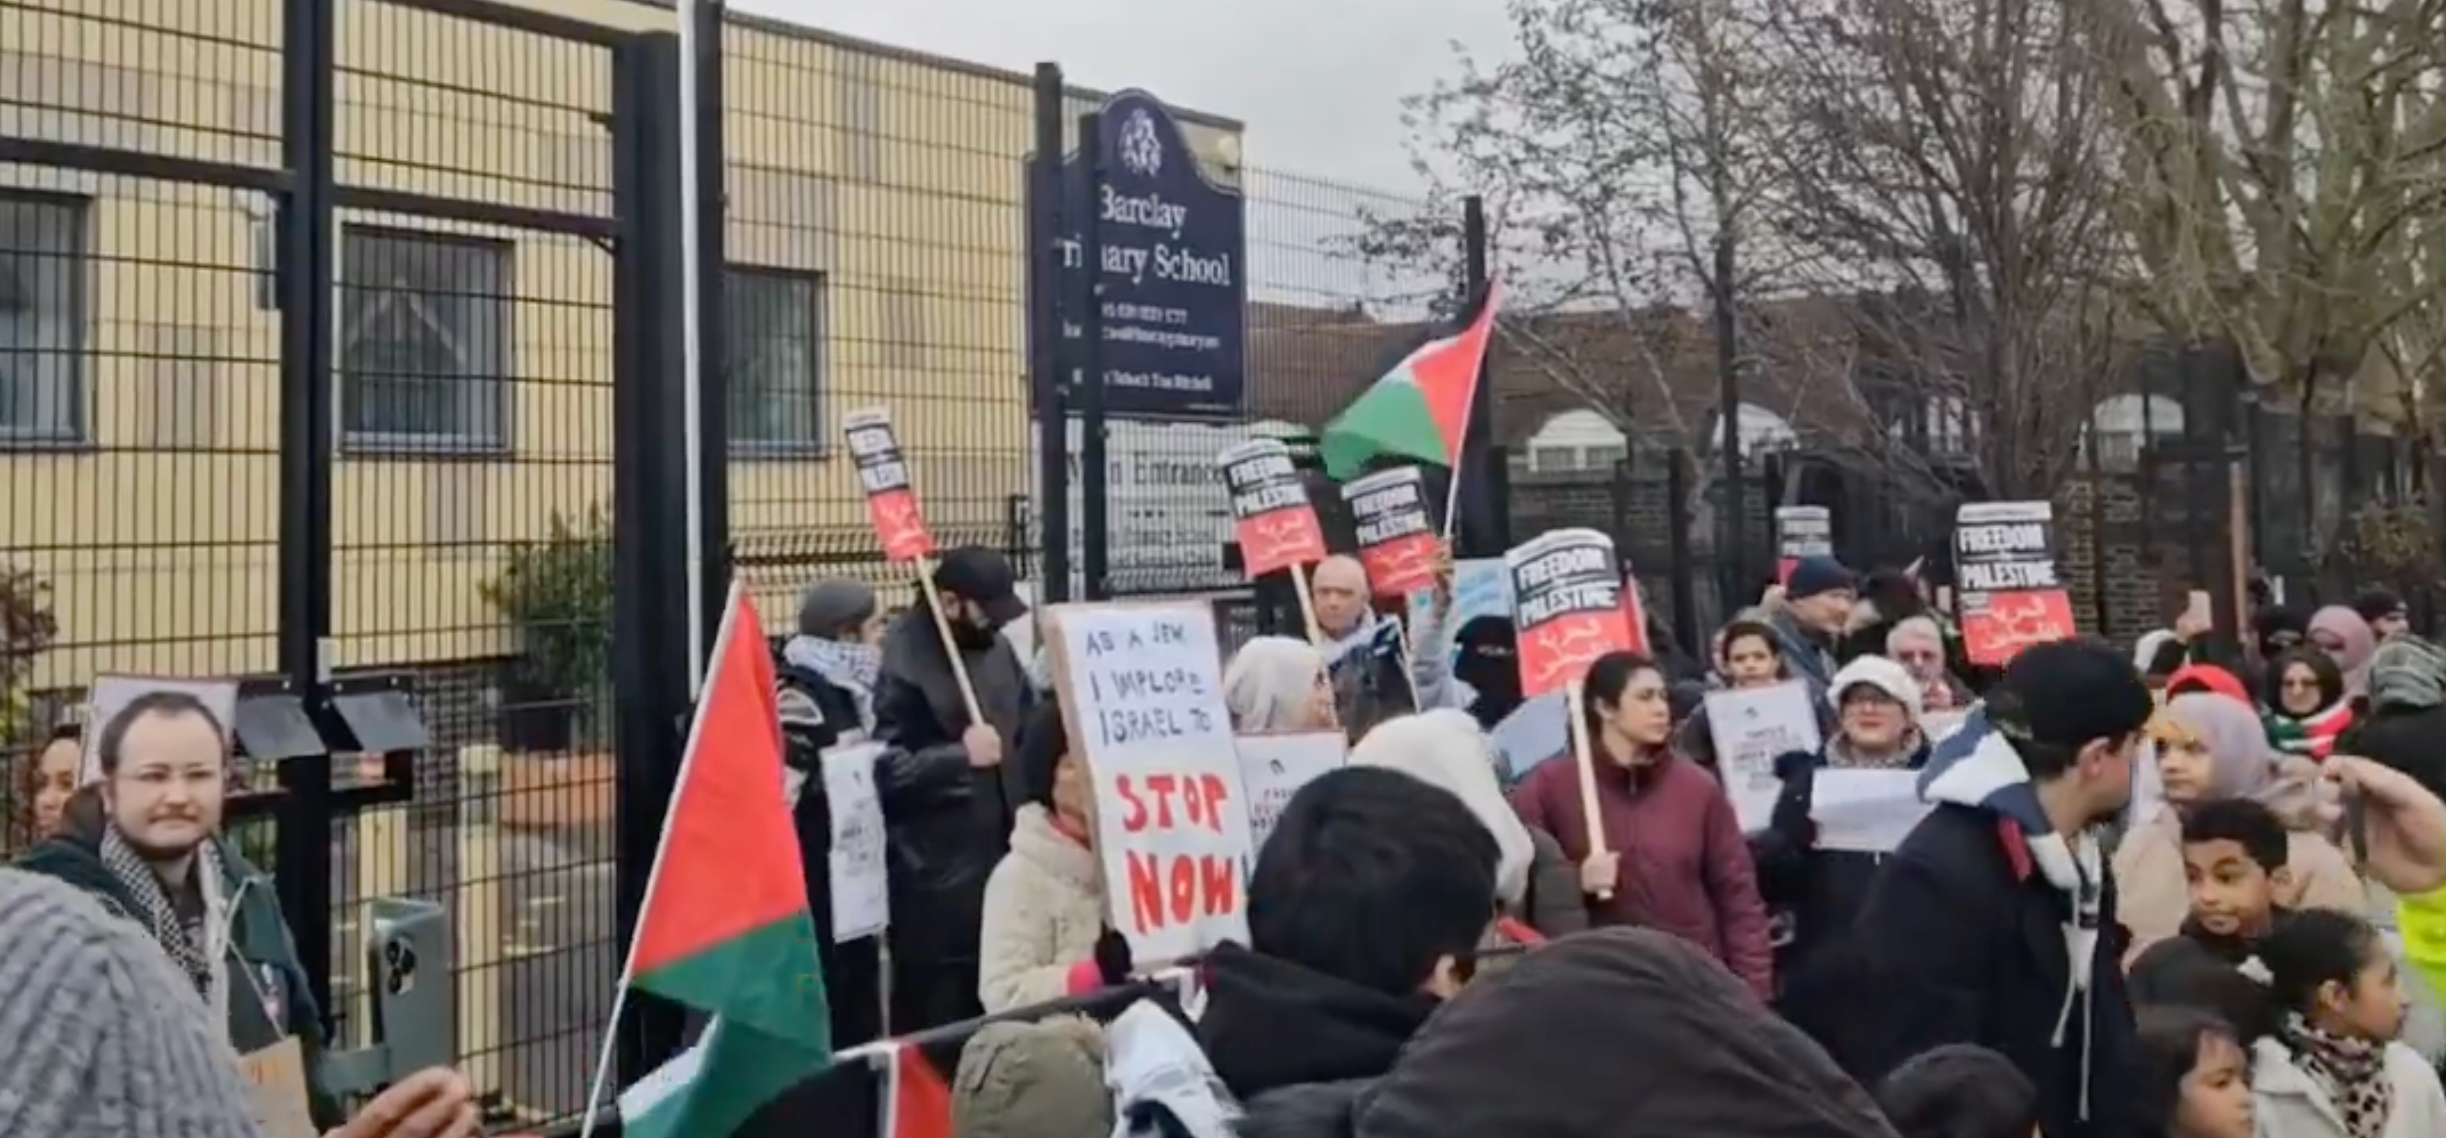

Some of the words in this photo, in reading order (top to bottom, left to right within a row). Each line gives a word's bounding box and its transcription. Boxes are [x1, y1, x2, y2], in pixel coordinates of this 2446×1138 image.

[1155, 242, 1230, 286] School
[1959, 523, 2045, 552] FREEDOM
[1517, 547, 1607, 592] FREEDOM
[1961, 560, 2057, 589] PALESTINE
[1519, 586, 1619, 629] PALESTINE
[1086, 631, 1115, 657] AS
[1128, 629, 1144, 649] A
[1152, 621, 1186, 645] JEW
[1090, 674, 1101, 701] I
[1110, 671, 1206, 699] IMPLORE
[1100, 708, 1183, 746] ISRAEL
[1189, 708, 1213, 734] TO
[1115, 773, 1229, 835] STOP
[1126, 849, 1234, 936] NOW
